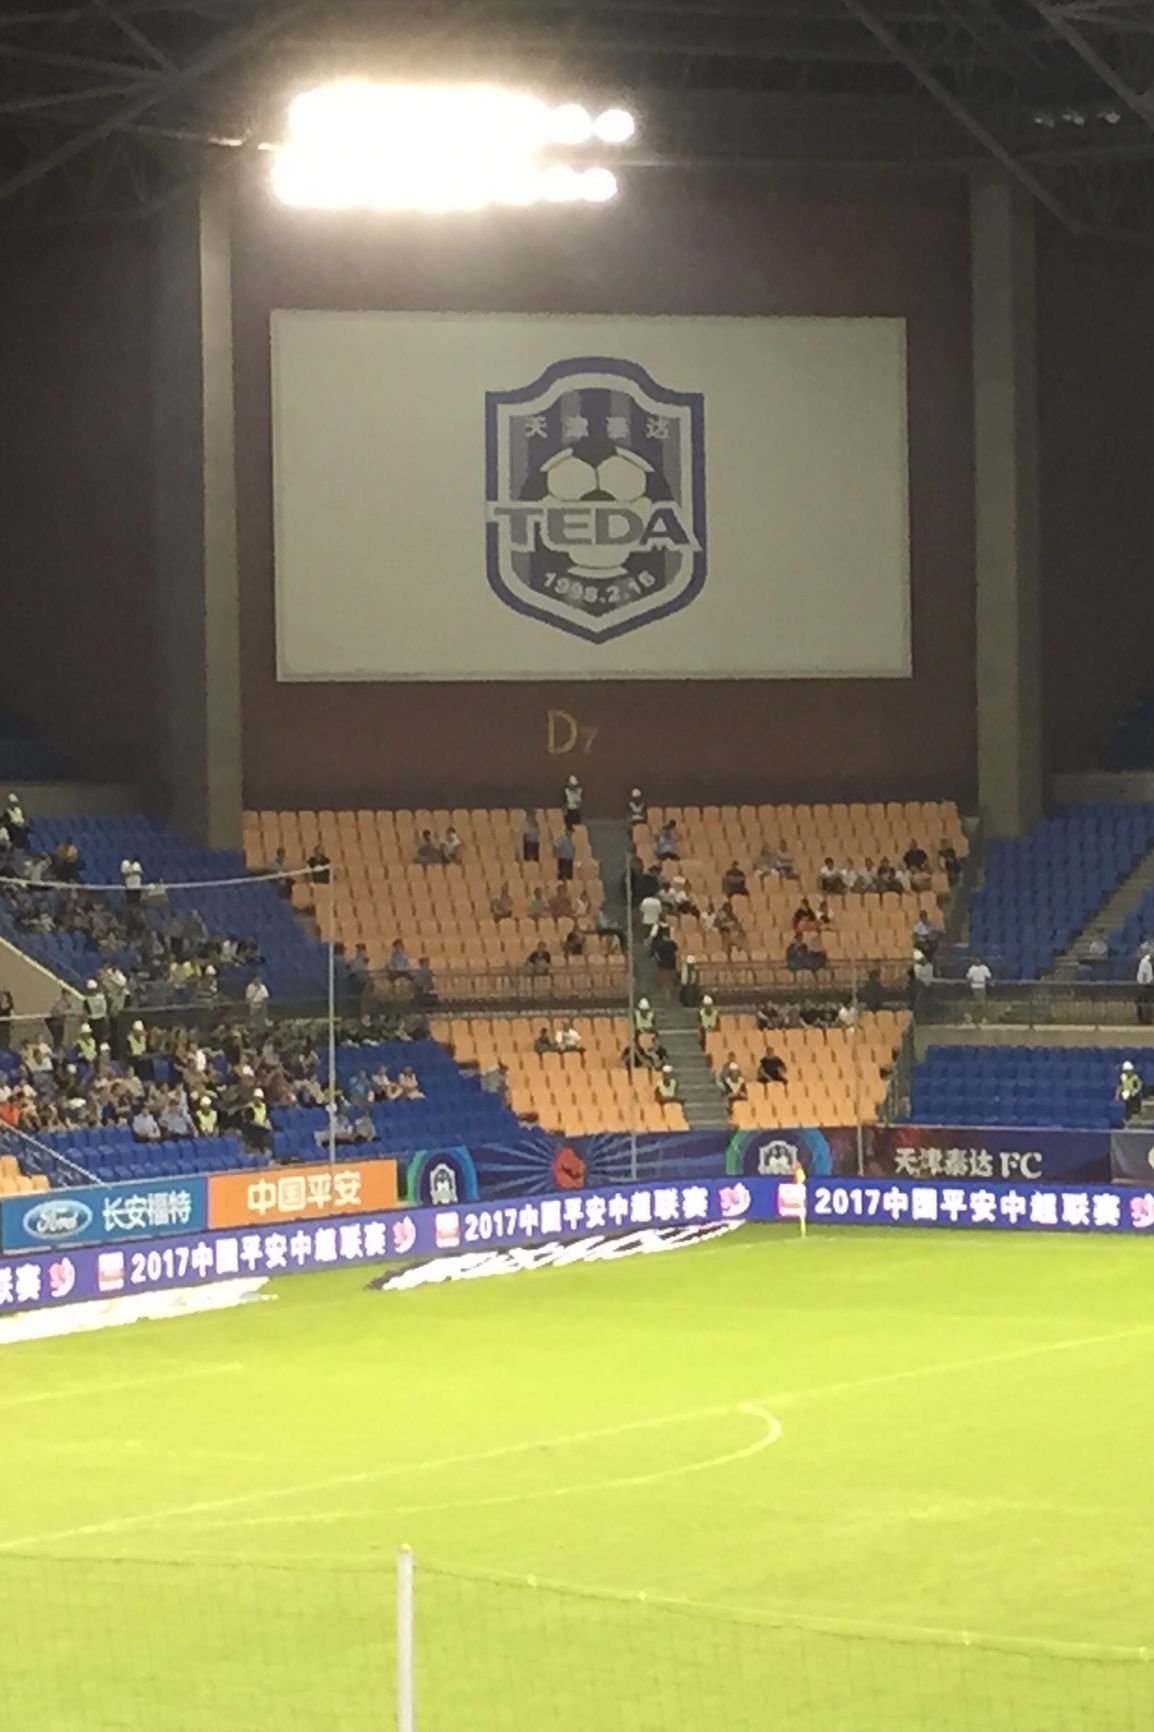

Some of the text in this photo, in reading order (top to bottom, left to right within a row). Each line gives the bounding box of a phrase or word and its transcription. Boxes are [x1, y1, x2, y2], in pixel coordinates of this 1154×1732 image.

[493, 505, 692, 547] TEDA
[547, 708, 599, 754] D7
[894, 1147, 1042, 1180] 天津泰达 FC
[102, 1189, 192, 1231] 长安福特
[247, 1169, 362, 1216] 中国平安
